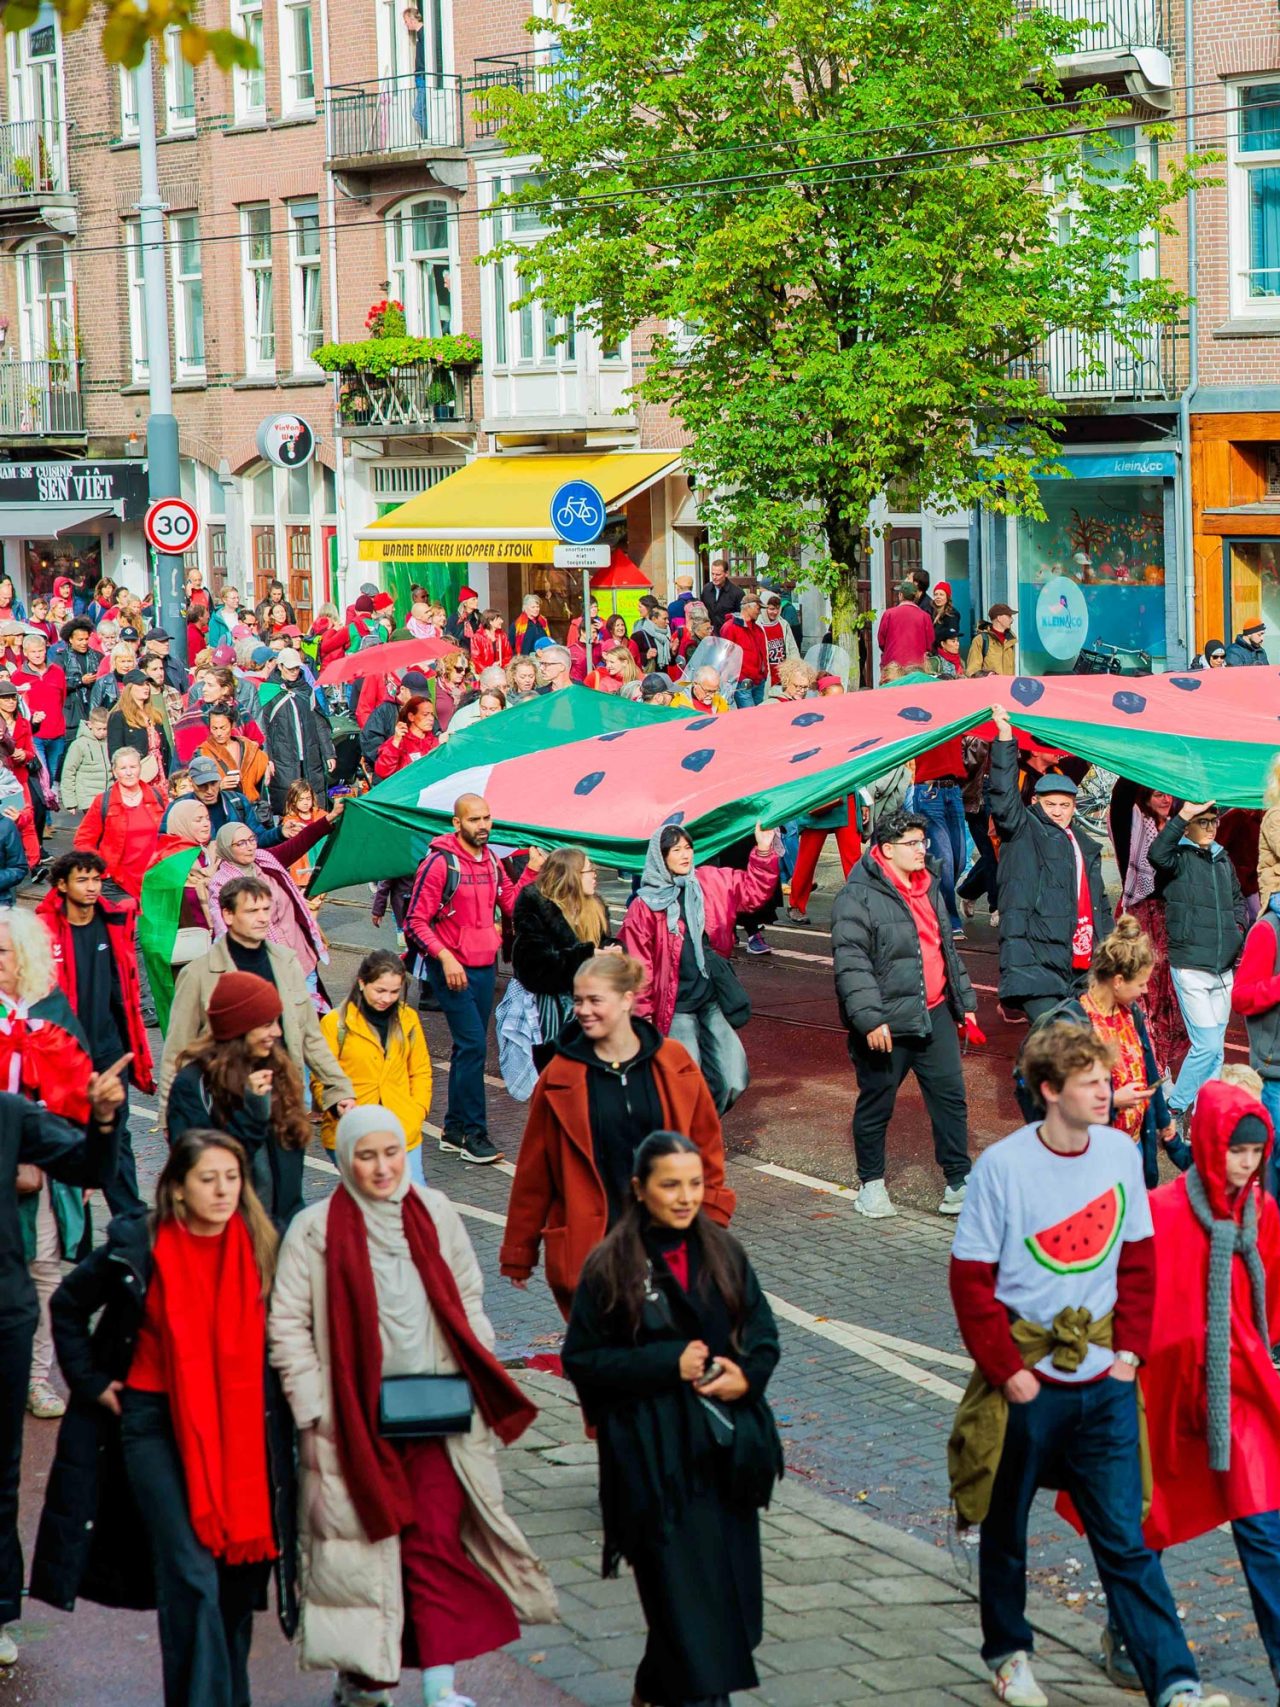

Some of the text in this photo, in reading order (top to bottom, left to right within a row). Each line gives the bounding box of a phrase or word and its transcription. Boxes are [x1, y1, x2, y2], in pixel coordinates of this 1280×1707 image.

[36, 465, 74, 478] CUISINE
[38, 476, 69, 501] SEN
[157, 516, 190, 536] 30
[382, 543, 414, 557] WARME
[416, 543, 454, 557] BAKKERS
[457, 543, 495, 557] KLOPPER
[503, 543, 533, 557] STOLK
